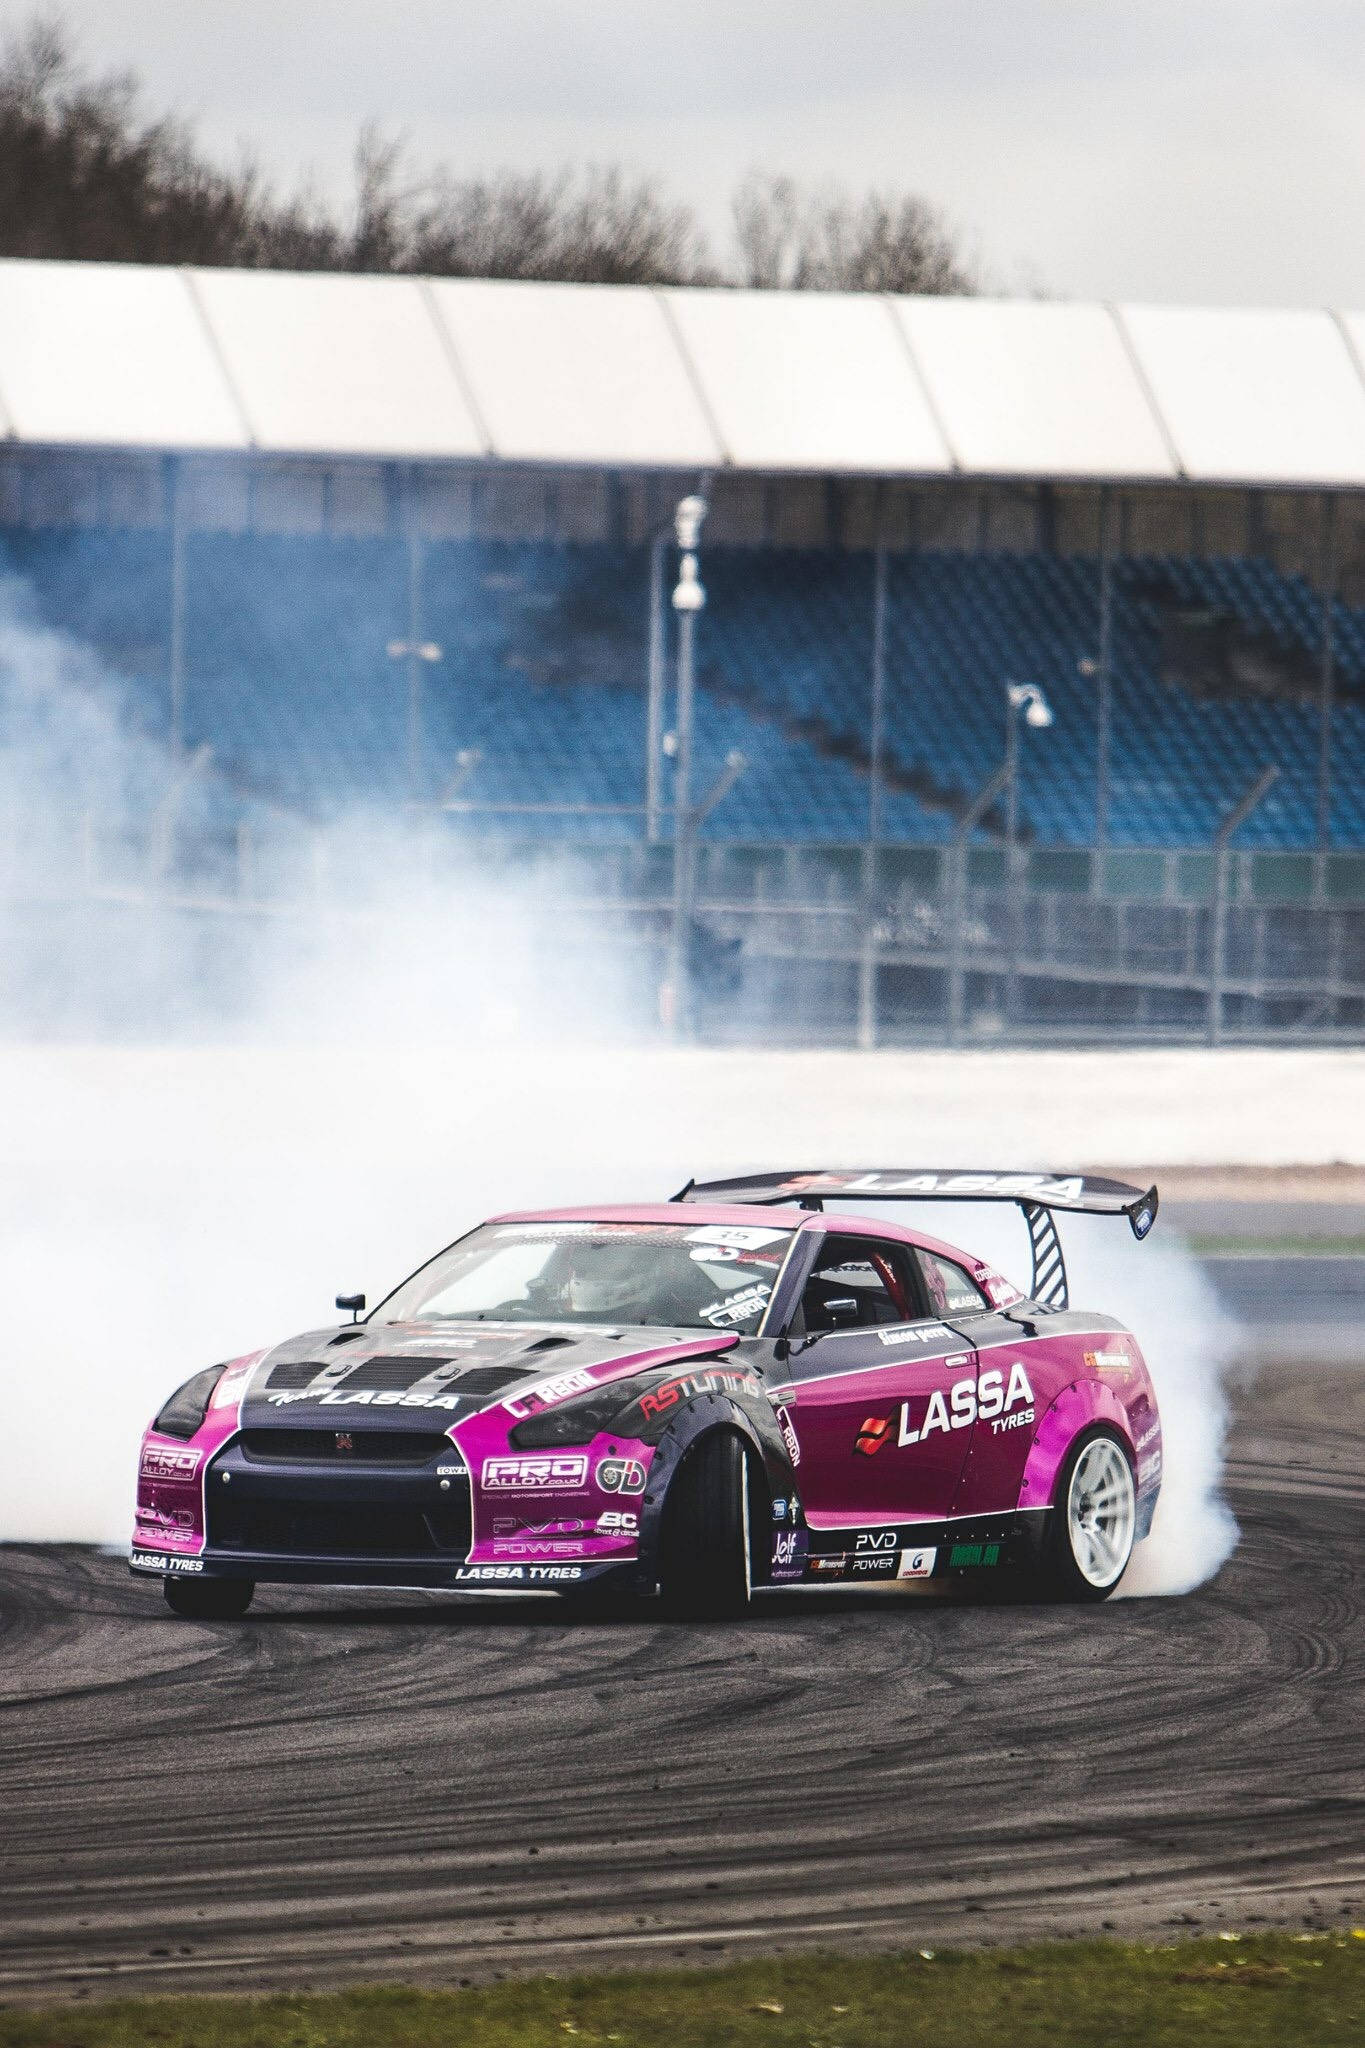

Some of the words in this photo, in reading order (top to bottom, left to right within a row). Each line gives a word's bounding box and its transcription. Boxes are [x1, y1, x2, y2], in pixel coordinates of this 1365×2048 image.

[842, 1174, 1083, 1200] LASSA
[708, 1296, 769, 1327] CRBON
[319, 1390, 461, 1409] LASSA
[898, 1363, 1035, 1447] LASSA
[991, 1408, 1035, 1434] TYRES
[776, 1405, 800, 1467] CRBON
[144, 1450, 200, 1469] PRO
[487, 1460, 583, 1478] PRO
[493, 1518, 584, 1534] PVD
[597, 1512, 638, 1528] BC
[493, 1542, 584, 1555] POWER
[856, 1532, 898, 1550] PVD
[131, 1554, 167, 1568] LASSA
[169, 1558, 205, 1571] TYRES
[852, 1557, 893, 1571] POWER
[455, 1567, 523, 1580] LASSA
[529, 1567, 582, 1579] TYRES
